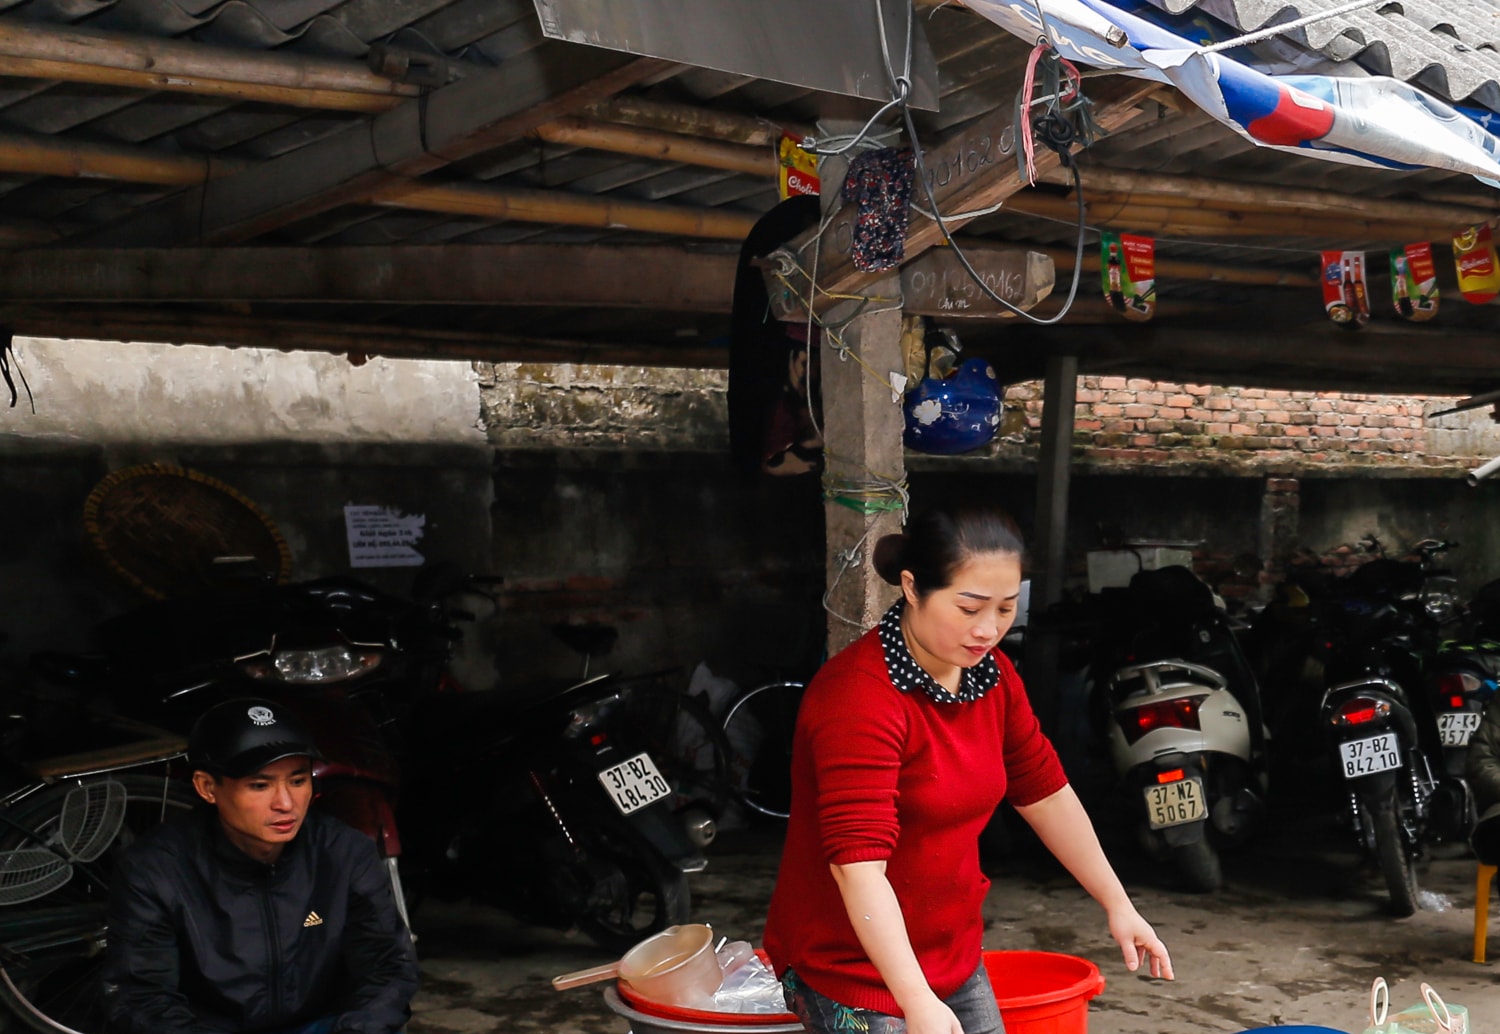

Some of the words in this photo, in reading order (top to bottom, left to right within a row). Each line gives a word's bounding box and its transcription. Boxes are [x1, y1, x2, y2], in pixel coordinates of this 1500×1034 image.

[1347, 736, 1390, 758] 37-B2
[607, 757, 651, 789] 37-B2
[1346, 752, 1398, 776] 842.10
[617, 775, 667, 810] 484.30
[1152, 781, 1195, 805] 37-N2
[1155, 800, 1196, 824] 5067
